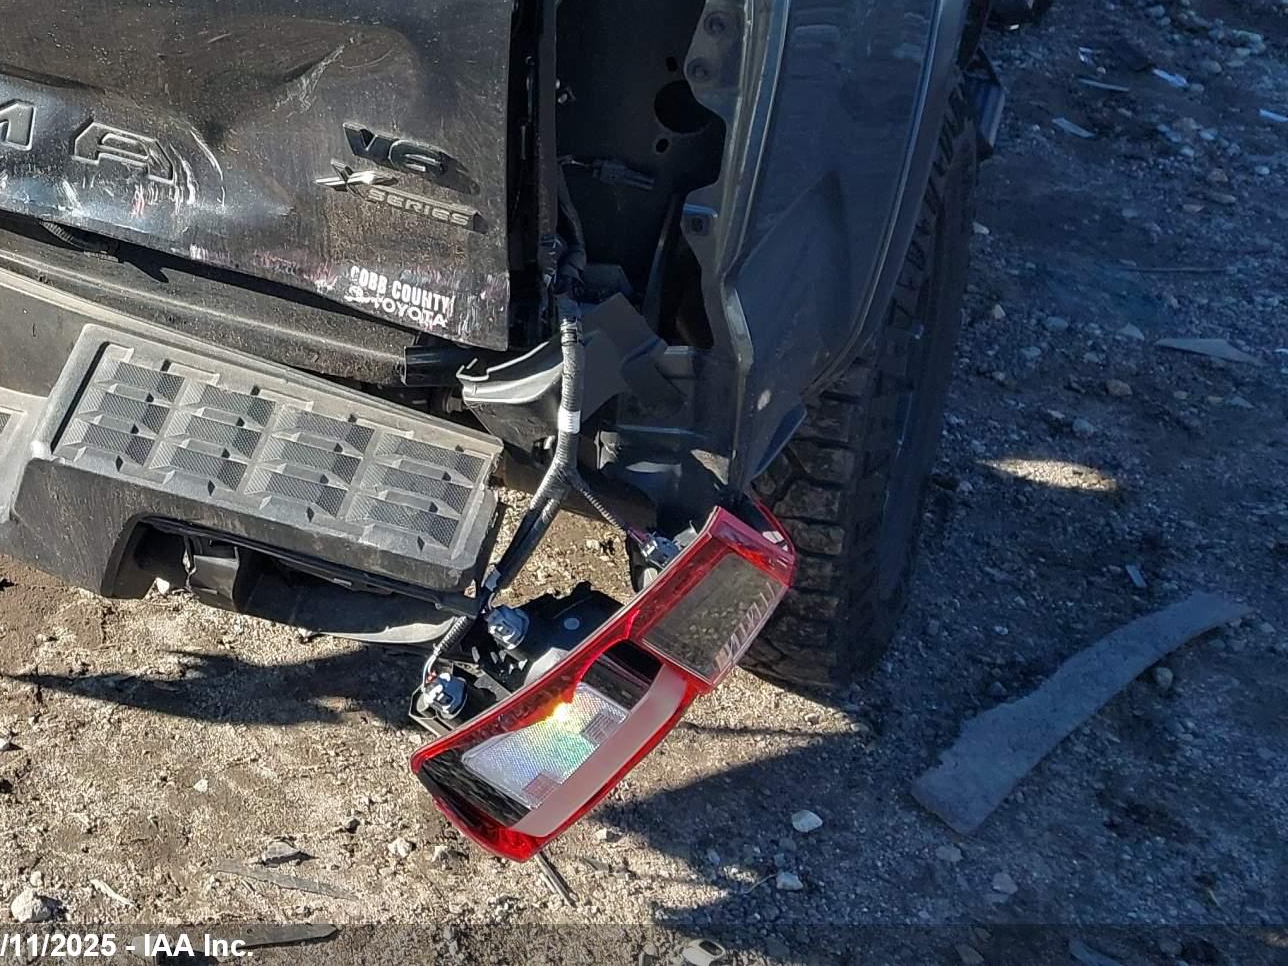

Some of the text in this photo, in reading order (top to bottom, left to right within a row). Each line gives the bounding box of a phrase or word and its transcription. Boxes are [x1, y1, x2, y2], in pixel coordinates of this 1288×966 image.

[343, 122, 450, 175] V6
[367, 187, 470, 226] SERIES
[372, 294, 448, 329] TOYOTA
[391, 280, 455, 317] COUNTY
